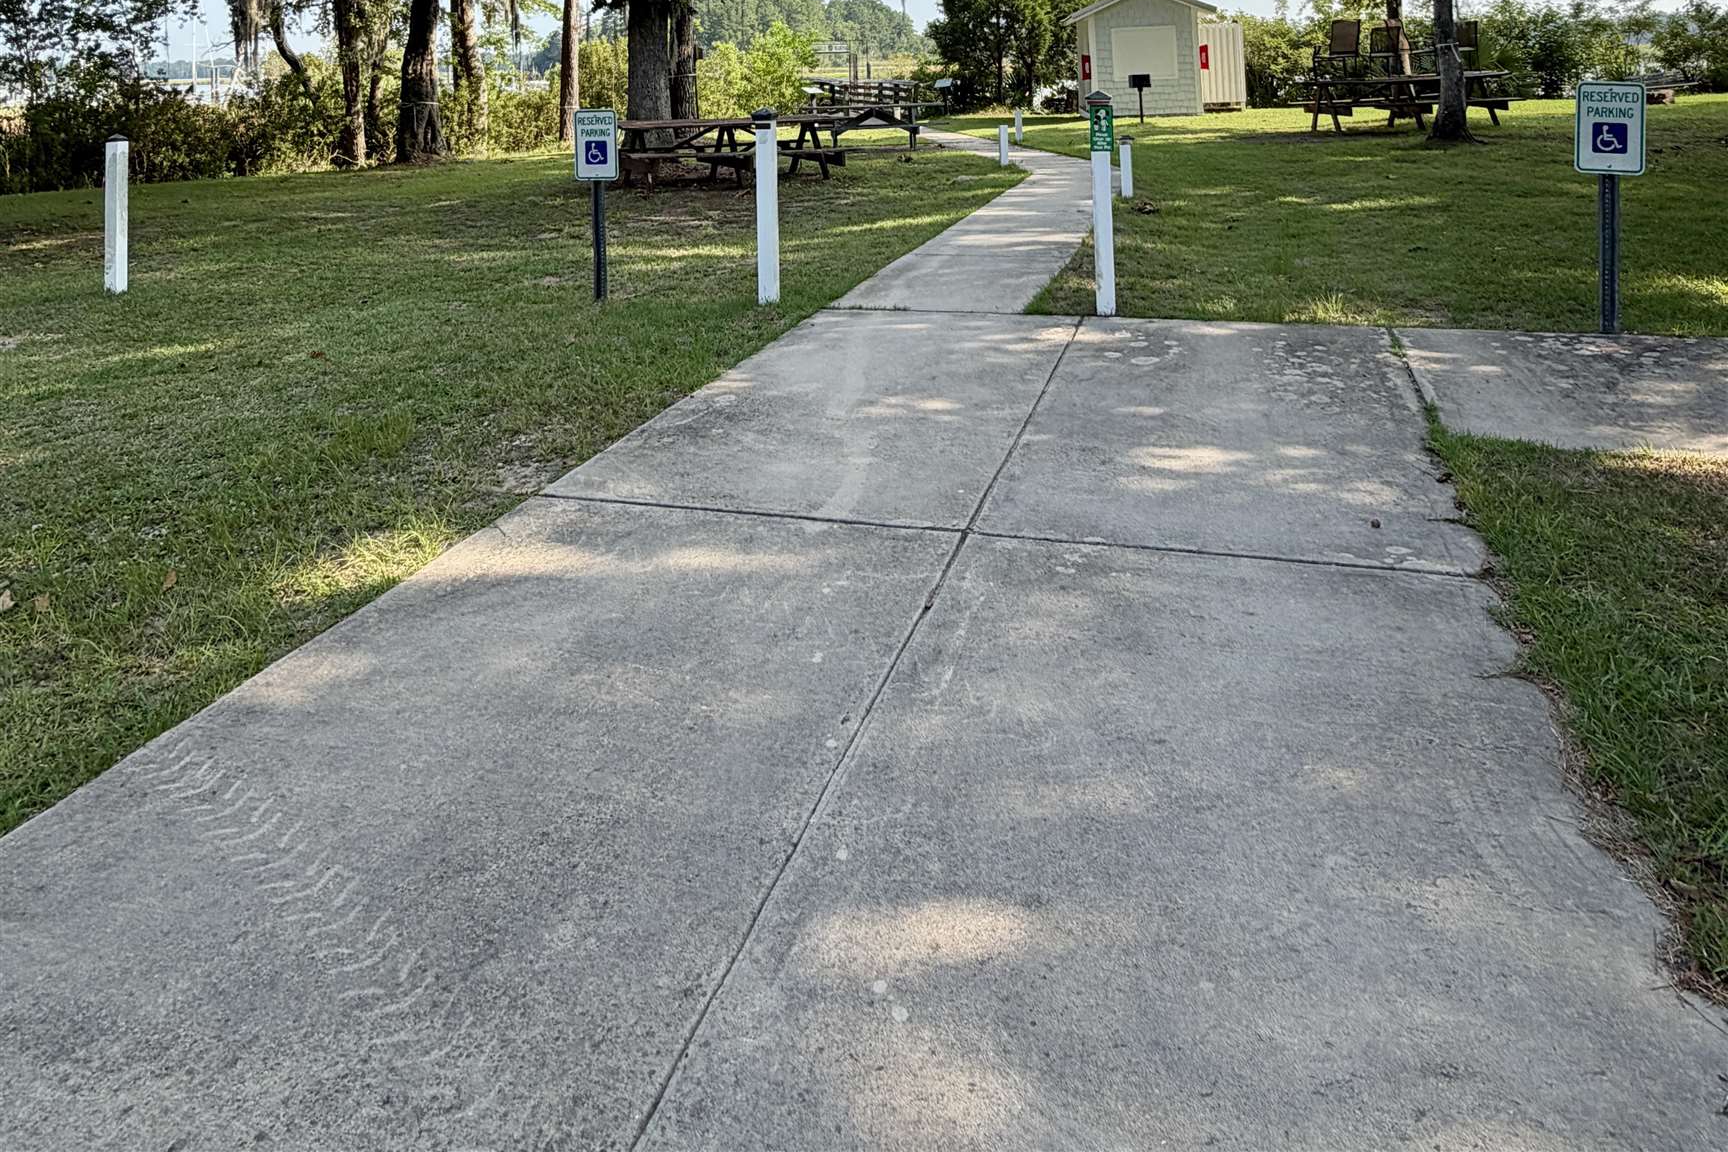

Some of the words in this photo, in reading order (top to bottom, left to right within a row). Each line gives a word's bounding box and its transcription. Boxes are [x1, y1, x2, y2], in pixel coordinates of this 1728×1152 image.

[1582, 91, 1640, 103] RESERVED
[1587, 106, 1634, 118] PARKING
[577, 116, 613, 126] RESERVED
[580, 128, 611, 137] PARKING
